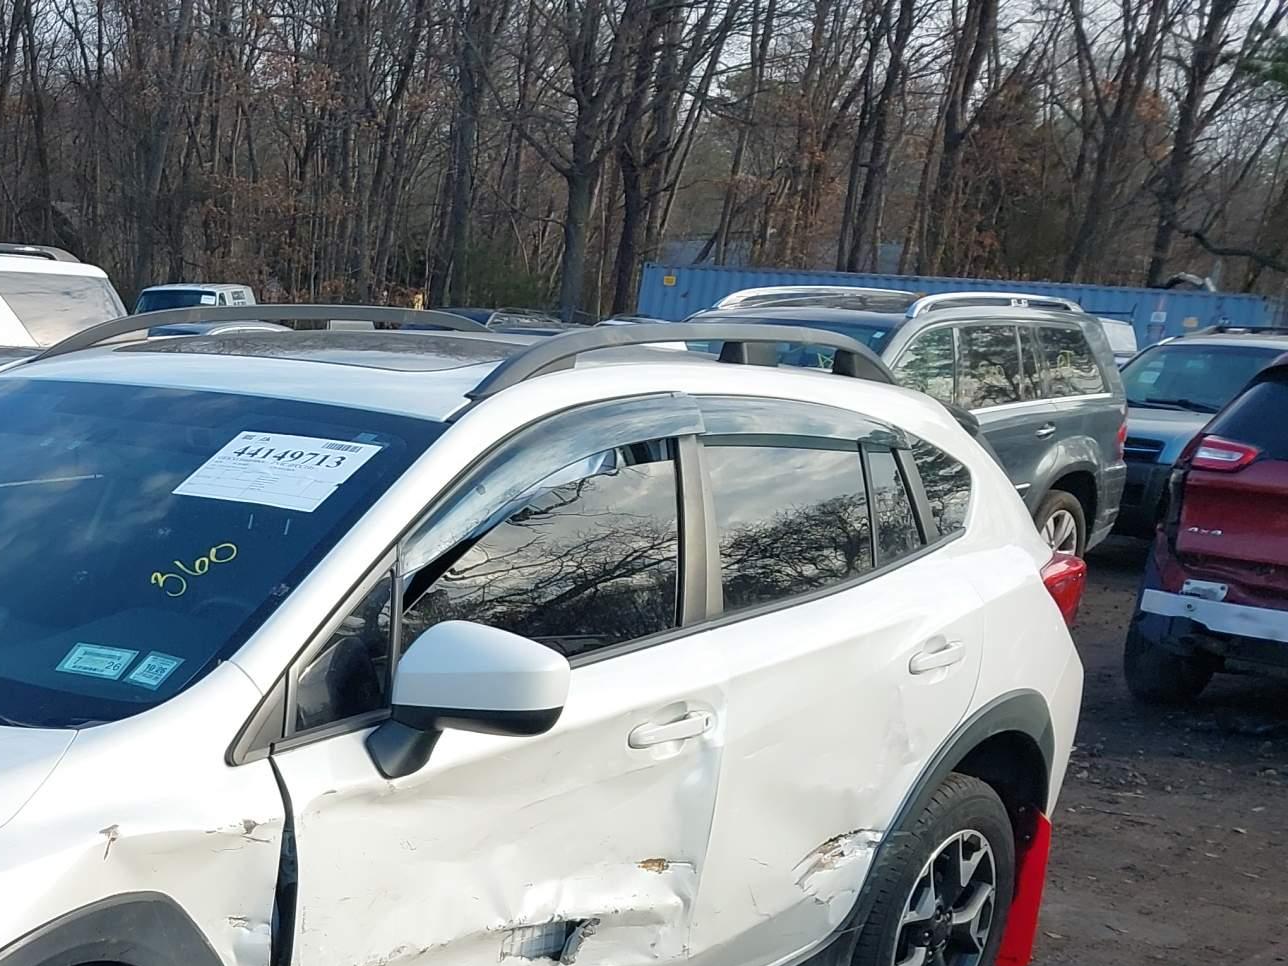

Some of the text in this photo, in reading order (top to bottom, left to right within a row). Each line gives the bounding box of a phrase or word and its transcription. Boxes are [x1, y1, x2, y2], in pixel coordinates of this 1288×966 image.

[233, 445, 347, 468] 44149713
[151, 542, 237, 597] 360
[105, 661, 122, 672] 26
